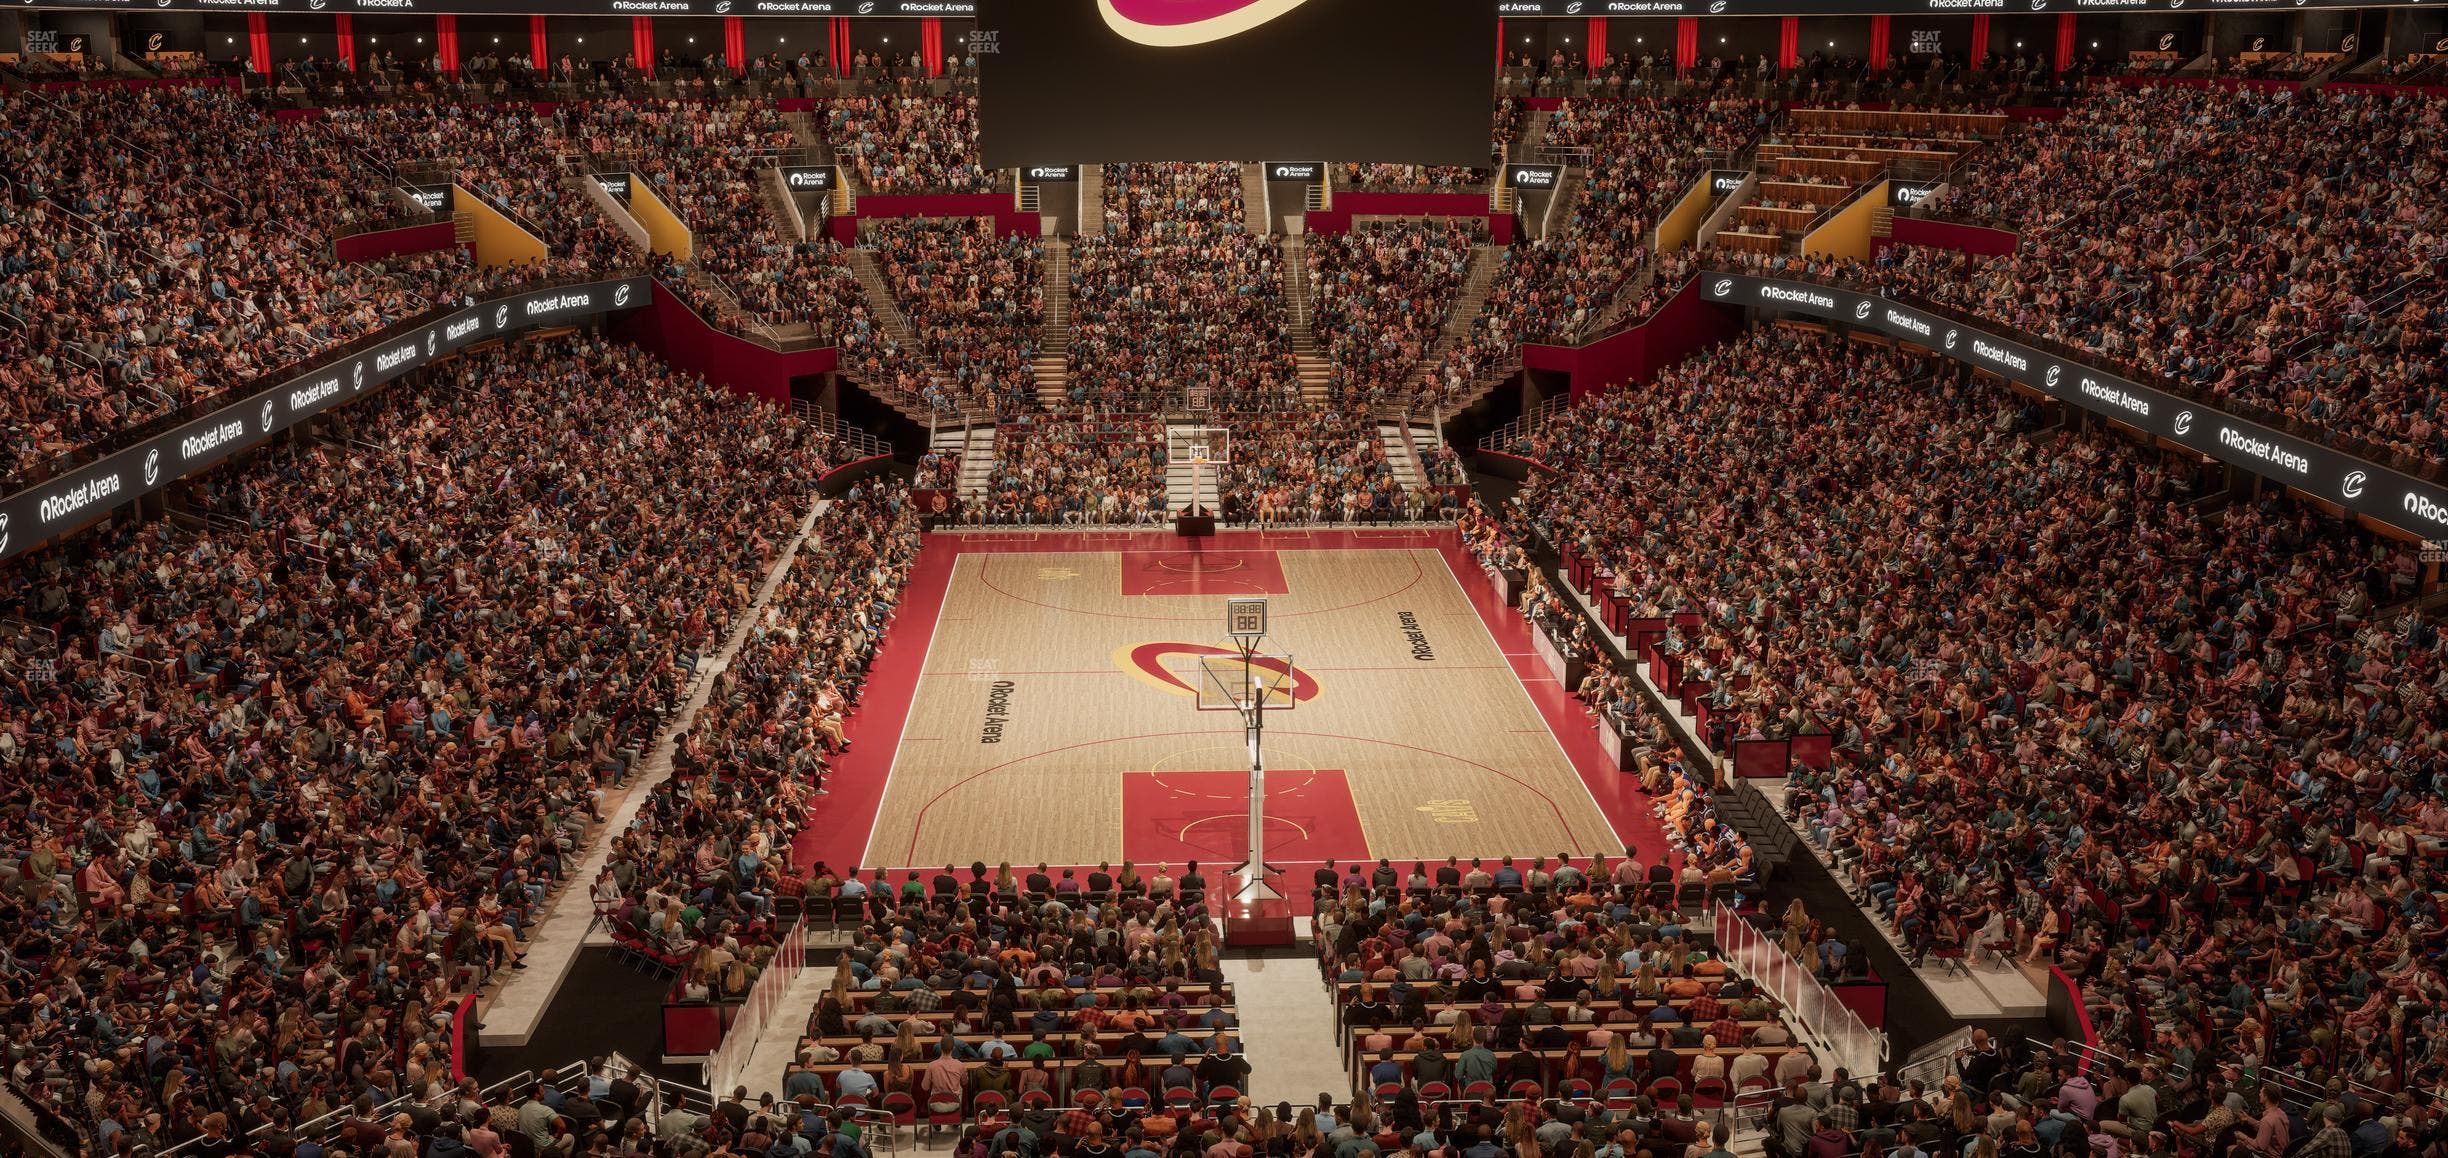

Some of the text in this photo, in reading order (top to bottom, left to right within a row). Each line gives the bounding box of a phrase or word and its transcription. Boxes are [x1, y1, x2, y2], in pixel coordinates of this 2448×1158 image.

[623, 1, 689, 10] Rocket Arena
[766, 2, 831, 11] Rocket Arena
[910, 3, 974, 11] Rocket Arena
[1511, 3, 1541, 11] Arena
[1617, 2, 1683, 10] Rocket Arena
[1938, 0, 1972, 8] Rocket
[533, 294, 589, 314] Rocket Arena
[1771, 287, 1834, 308] Rocket Arena
[451, 316, 479, 340] Rocket Arena
[1892, 312, 1930, 336] Rocket Arena
[381, 344, 416, 372] Rocket Arena
[1980, 342, 2026, 371] Rocket Arena
[297, 378, 339, 408] Rocket Arena
[2089, 380, 2149, 415] Rocket Arena
[190, 420, 243, 457] Rocket Arena
[2230, 430, 2308, 474] Rocket Arena
[50, 473, 120, 520] Rocket Arena
[1237, 615, 1257, 630] 88
[1397, 611, 1432, 655] Rocket Arena
[980, 688, 1015, 743] Rocket Arena
